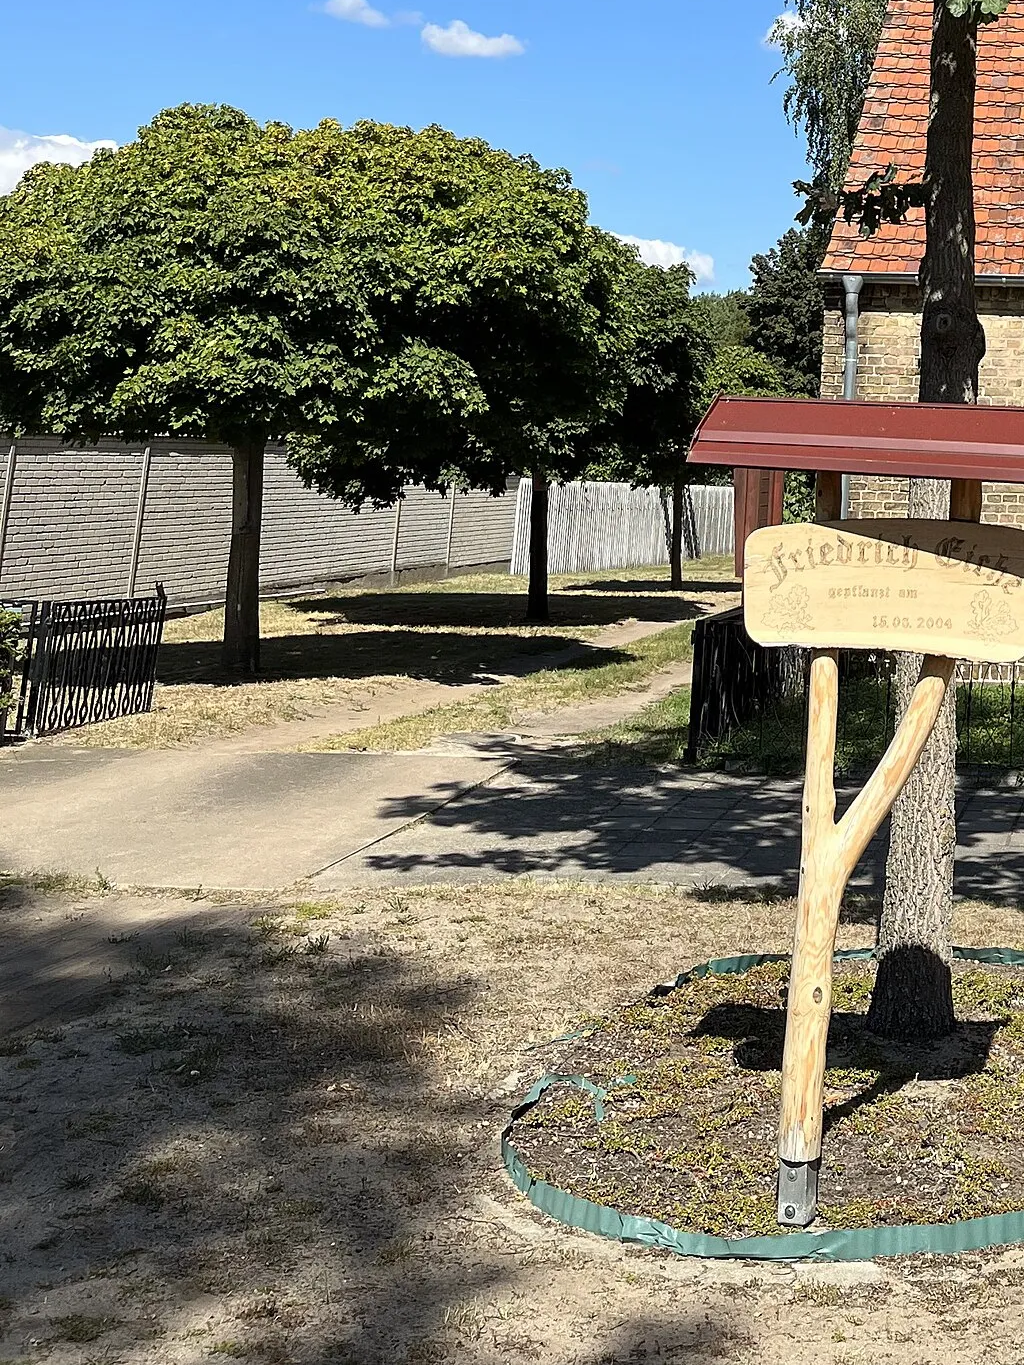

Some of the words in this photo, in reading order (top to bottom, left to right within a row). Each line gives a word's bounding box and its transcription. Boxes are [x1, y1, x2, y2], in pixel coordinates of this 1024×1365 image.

[763, 533, 919, 593] Friedrich
[827, 584, 890, 600] gepflanzt
[898, 587, 919, 599] am
